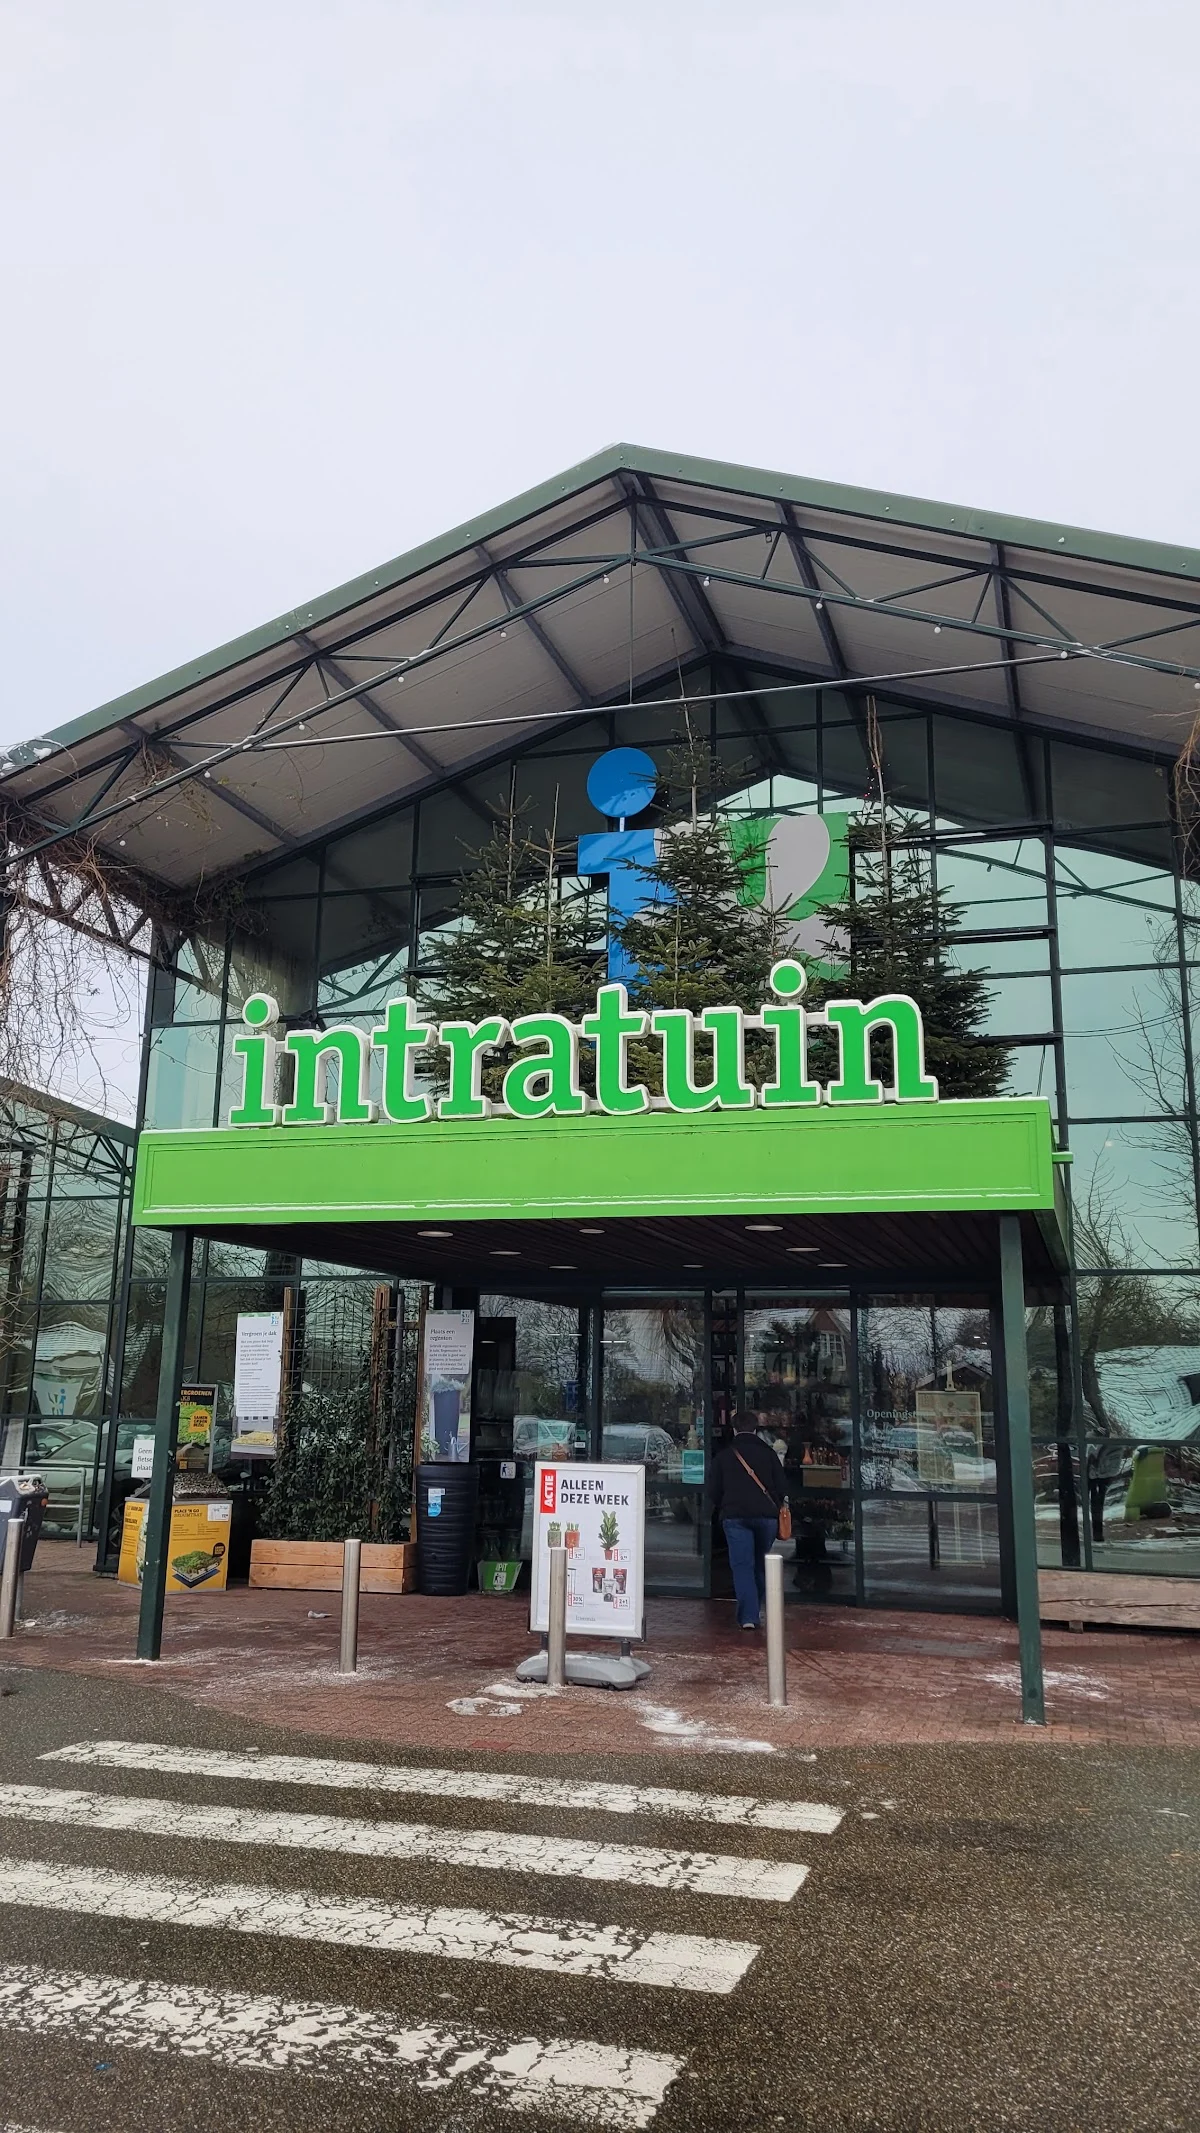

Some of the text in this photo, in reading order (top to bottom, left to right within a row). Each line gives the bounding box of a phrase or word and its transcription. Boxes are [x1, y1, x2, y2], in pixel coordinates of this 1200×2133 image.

[230, 959, 941, 1127] intratuin
[866, 1409, 919, 1420] Openingst
[544, 1475, 554, 1507] ACTIE
[560, 1479, 604, 1491] ALLEEN
[560, 1493, 629, 1506] DEZE WEEK
